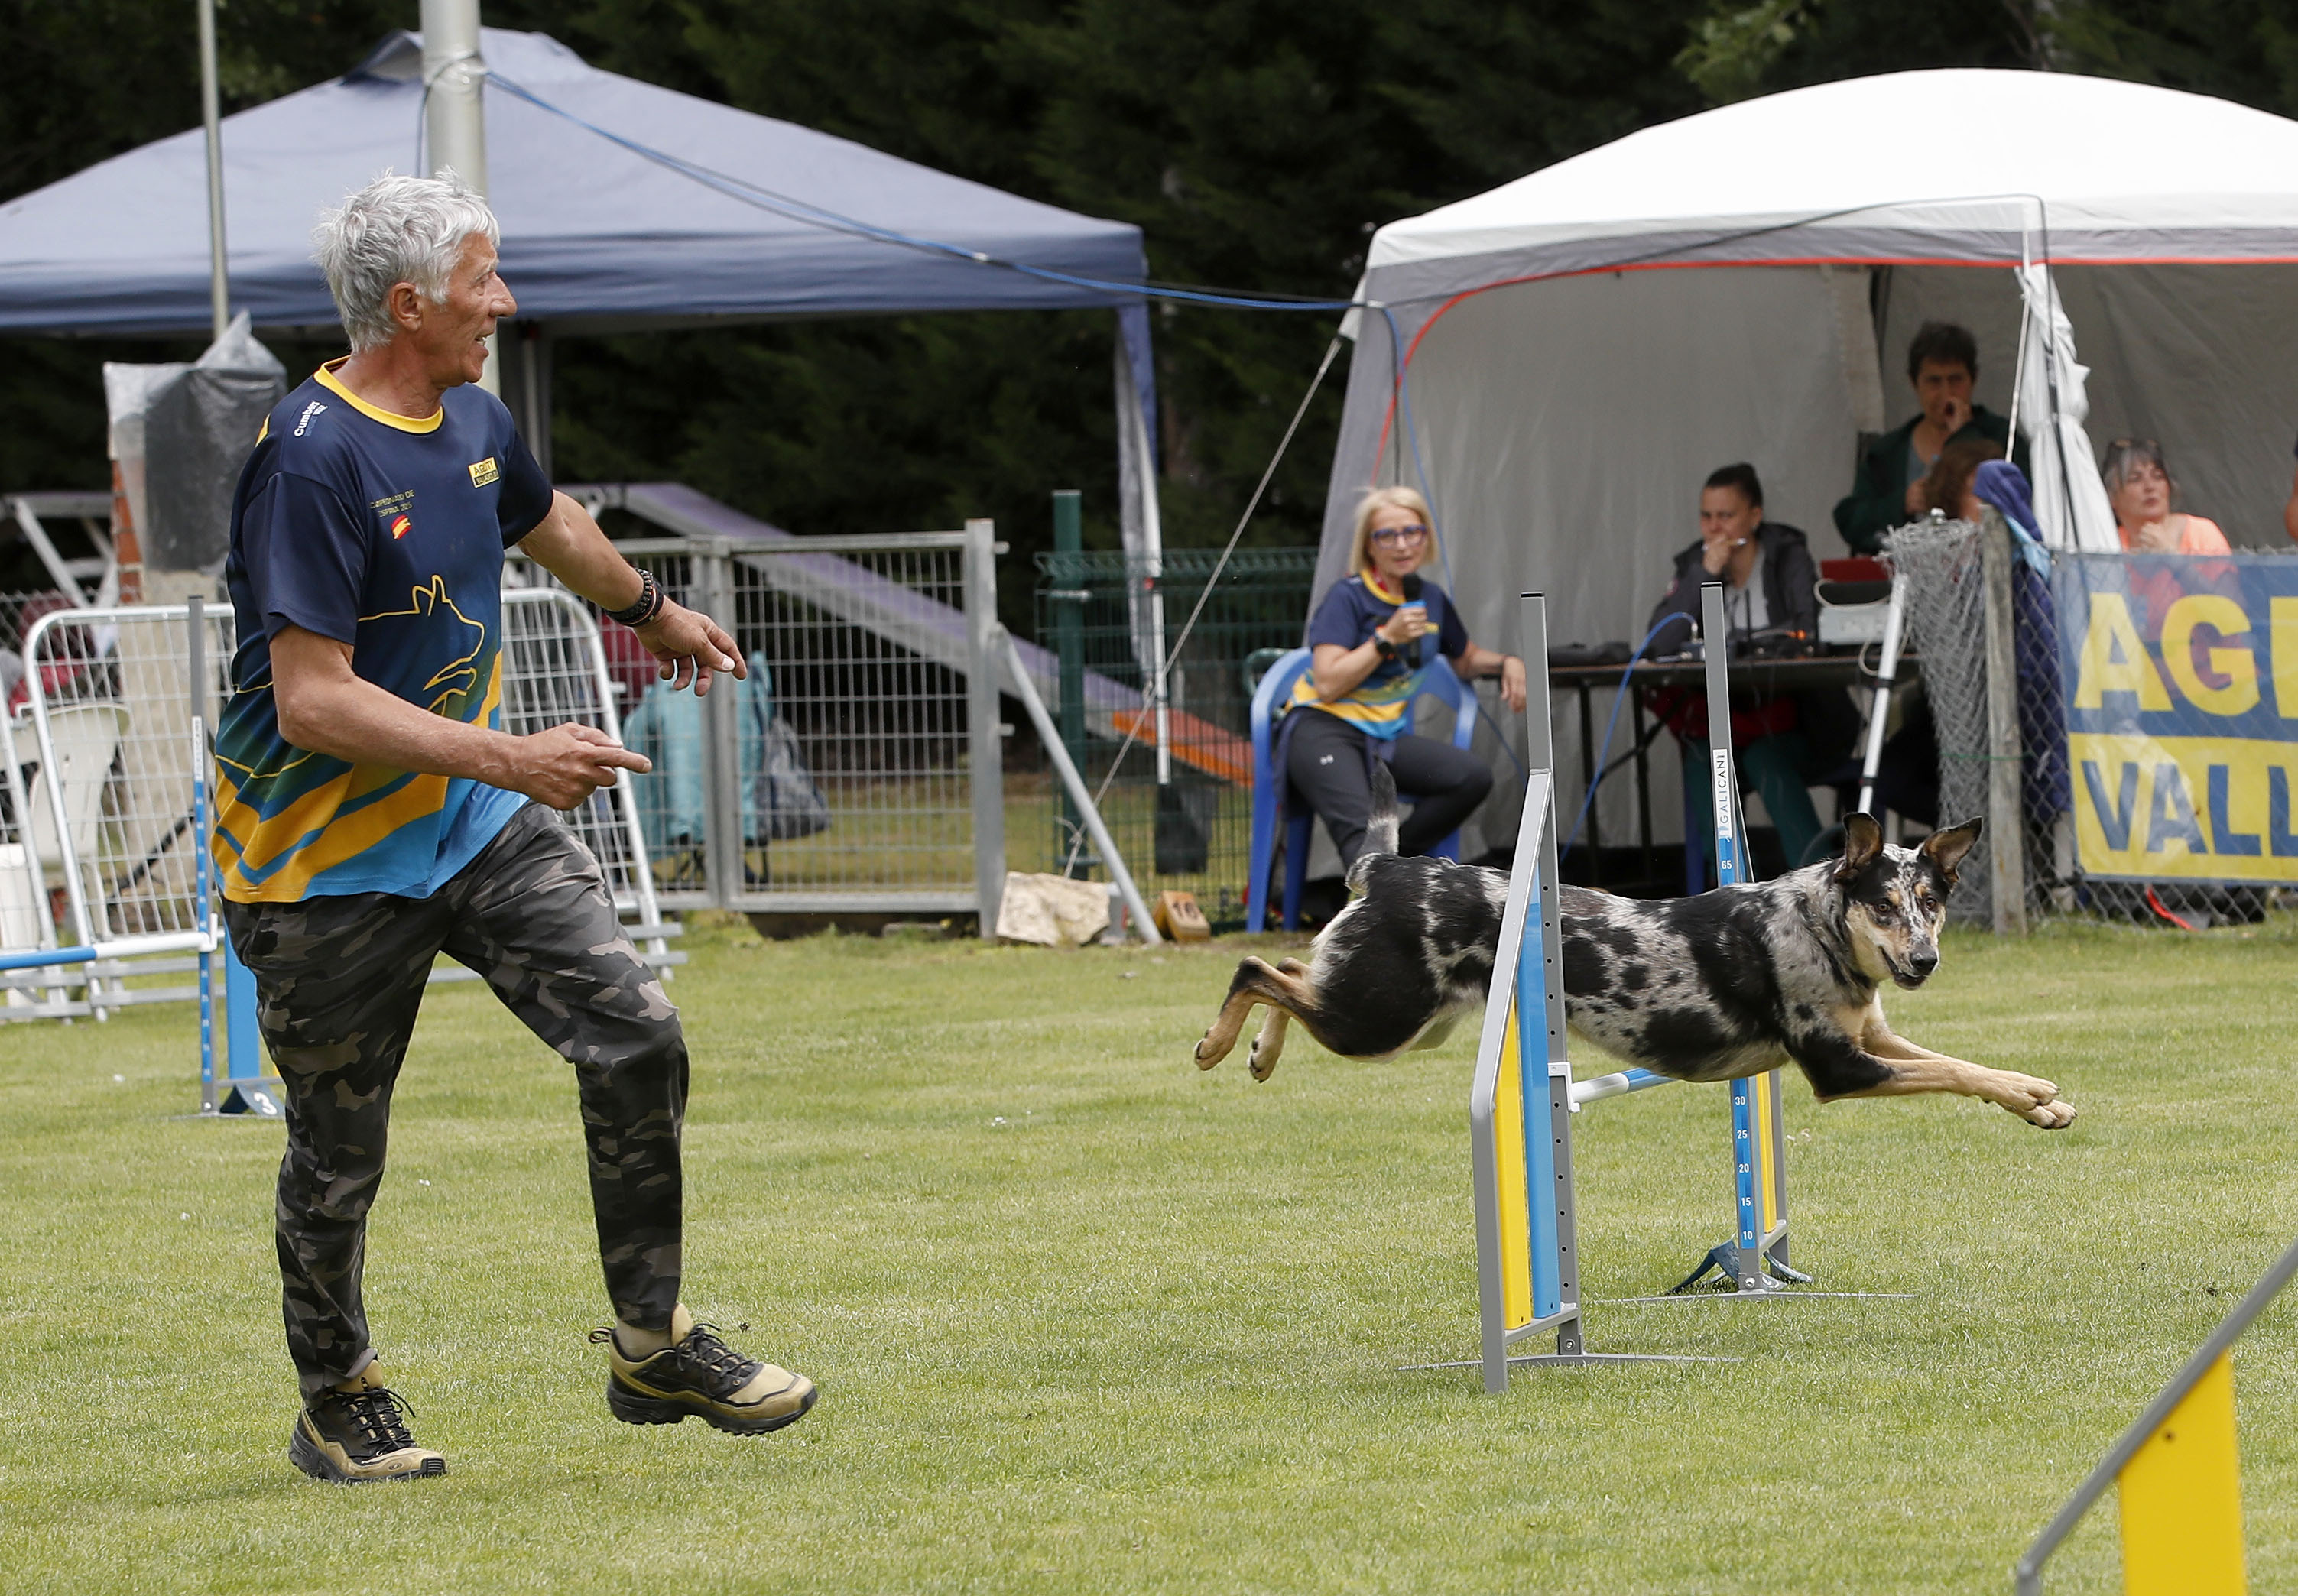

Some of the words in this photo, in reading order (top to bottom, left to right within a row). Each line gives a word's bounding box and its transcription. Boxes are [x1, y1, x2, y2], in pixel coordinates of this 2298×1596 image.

[1721, 860, 1732, 870] 65
[254, 1091, 278, 1115] 3
[1735, 1096, 1746, 1106] 30
[1736, 1130, 1748, 1139] 25
[1738, 1163, 1750, 1173] 20
[1741, 1197, 1751, 1207] 15
[1743, 1230, 1753, 1240] 10
